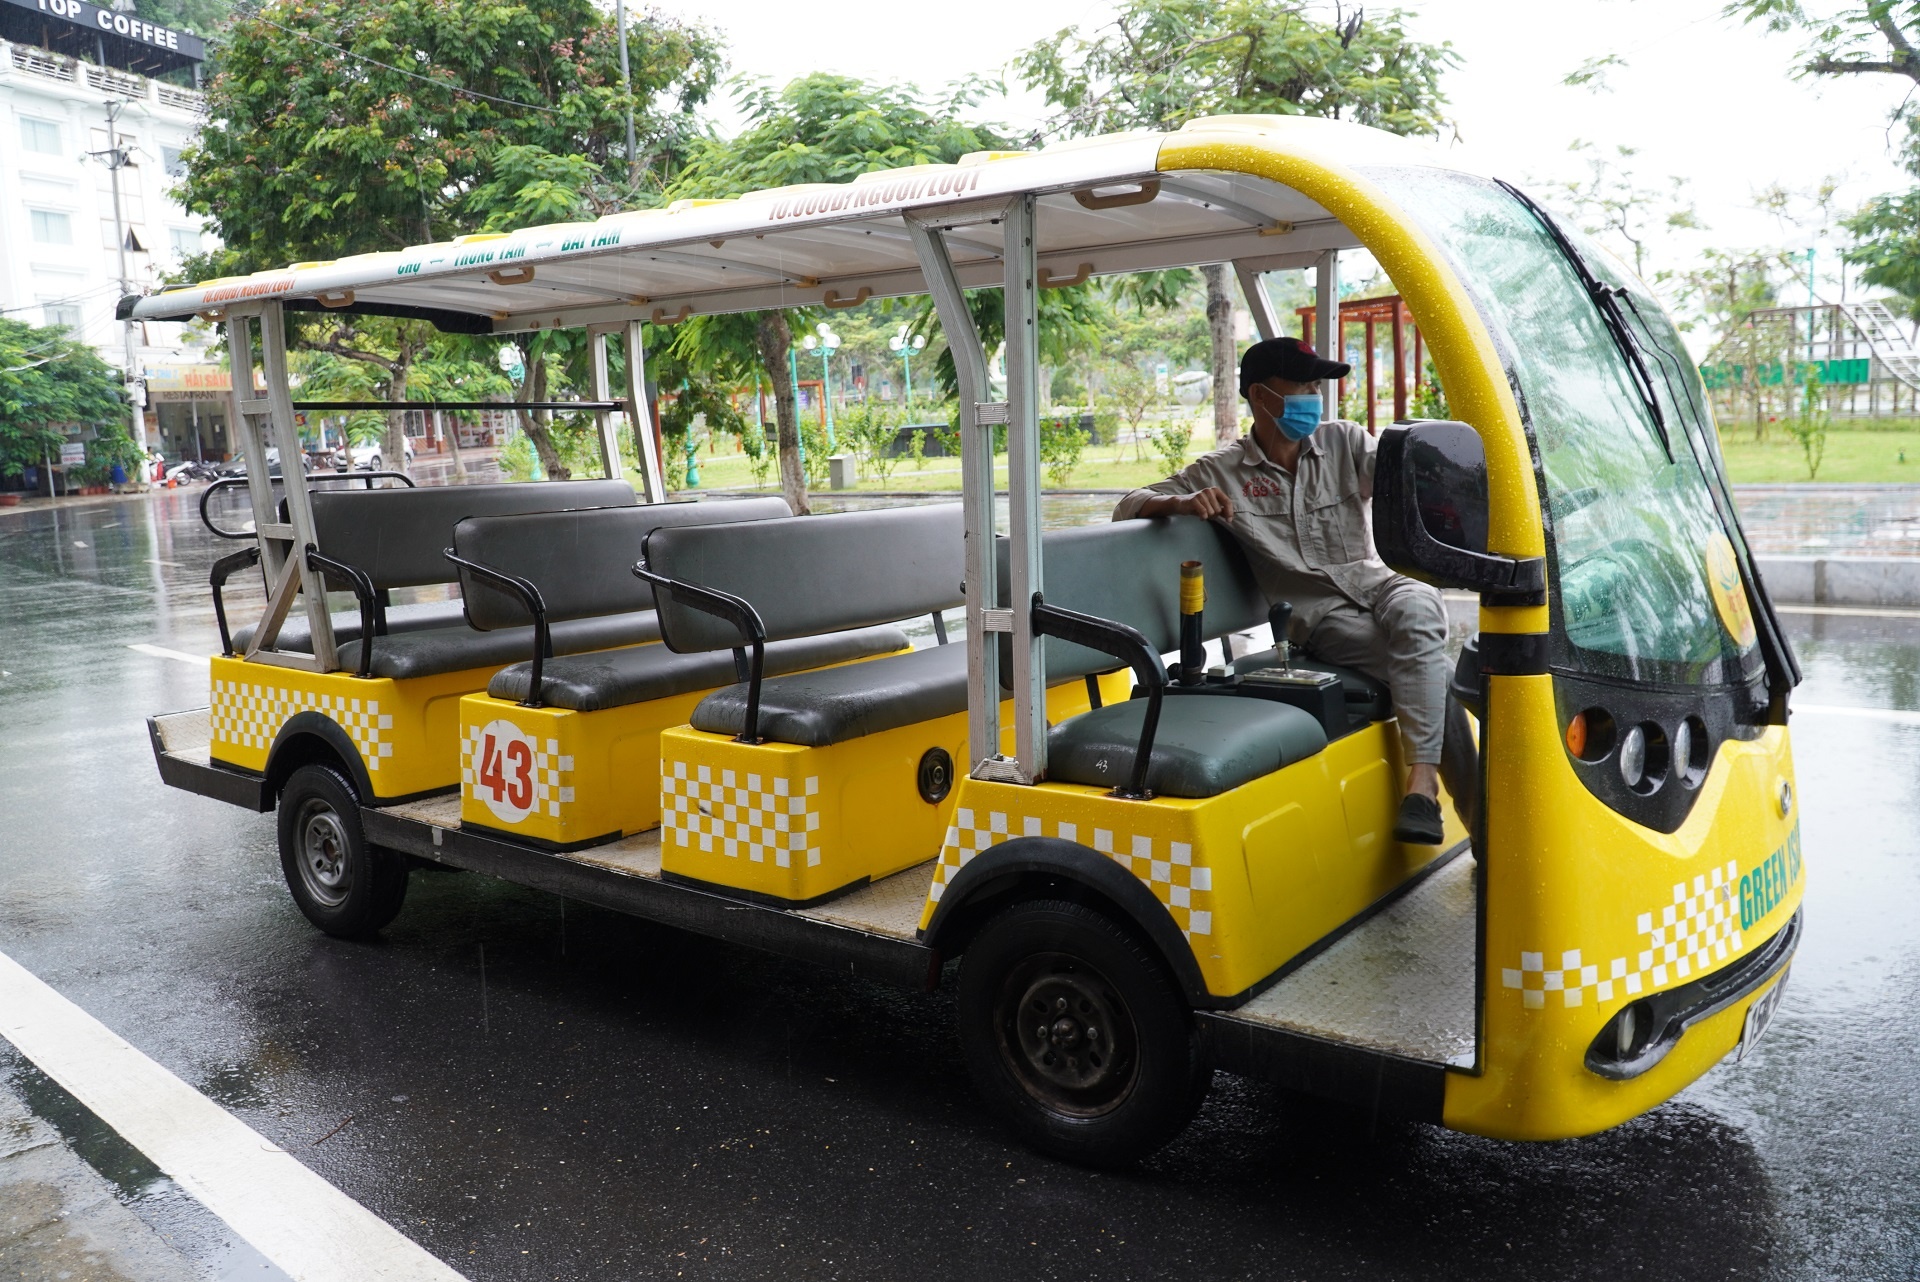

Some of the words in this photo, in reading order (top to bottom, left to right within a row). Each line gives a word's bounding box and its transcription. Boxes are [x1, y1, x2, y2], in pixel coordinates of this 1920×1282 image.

[97, 9, 179, 50] COFFEE
[1252, 486, 1269, 497] 69
[480, 733, 534, 810] 43
[1095, 759, 1108, 773] 43
[1739, 844, 1788, 931] GREEN
